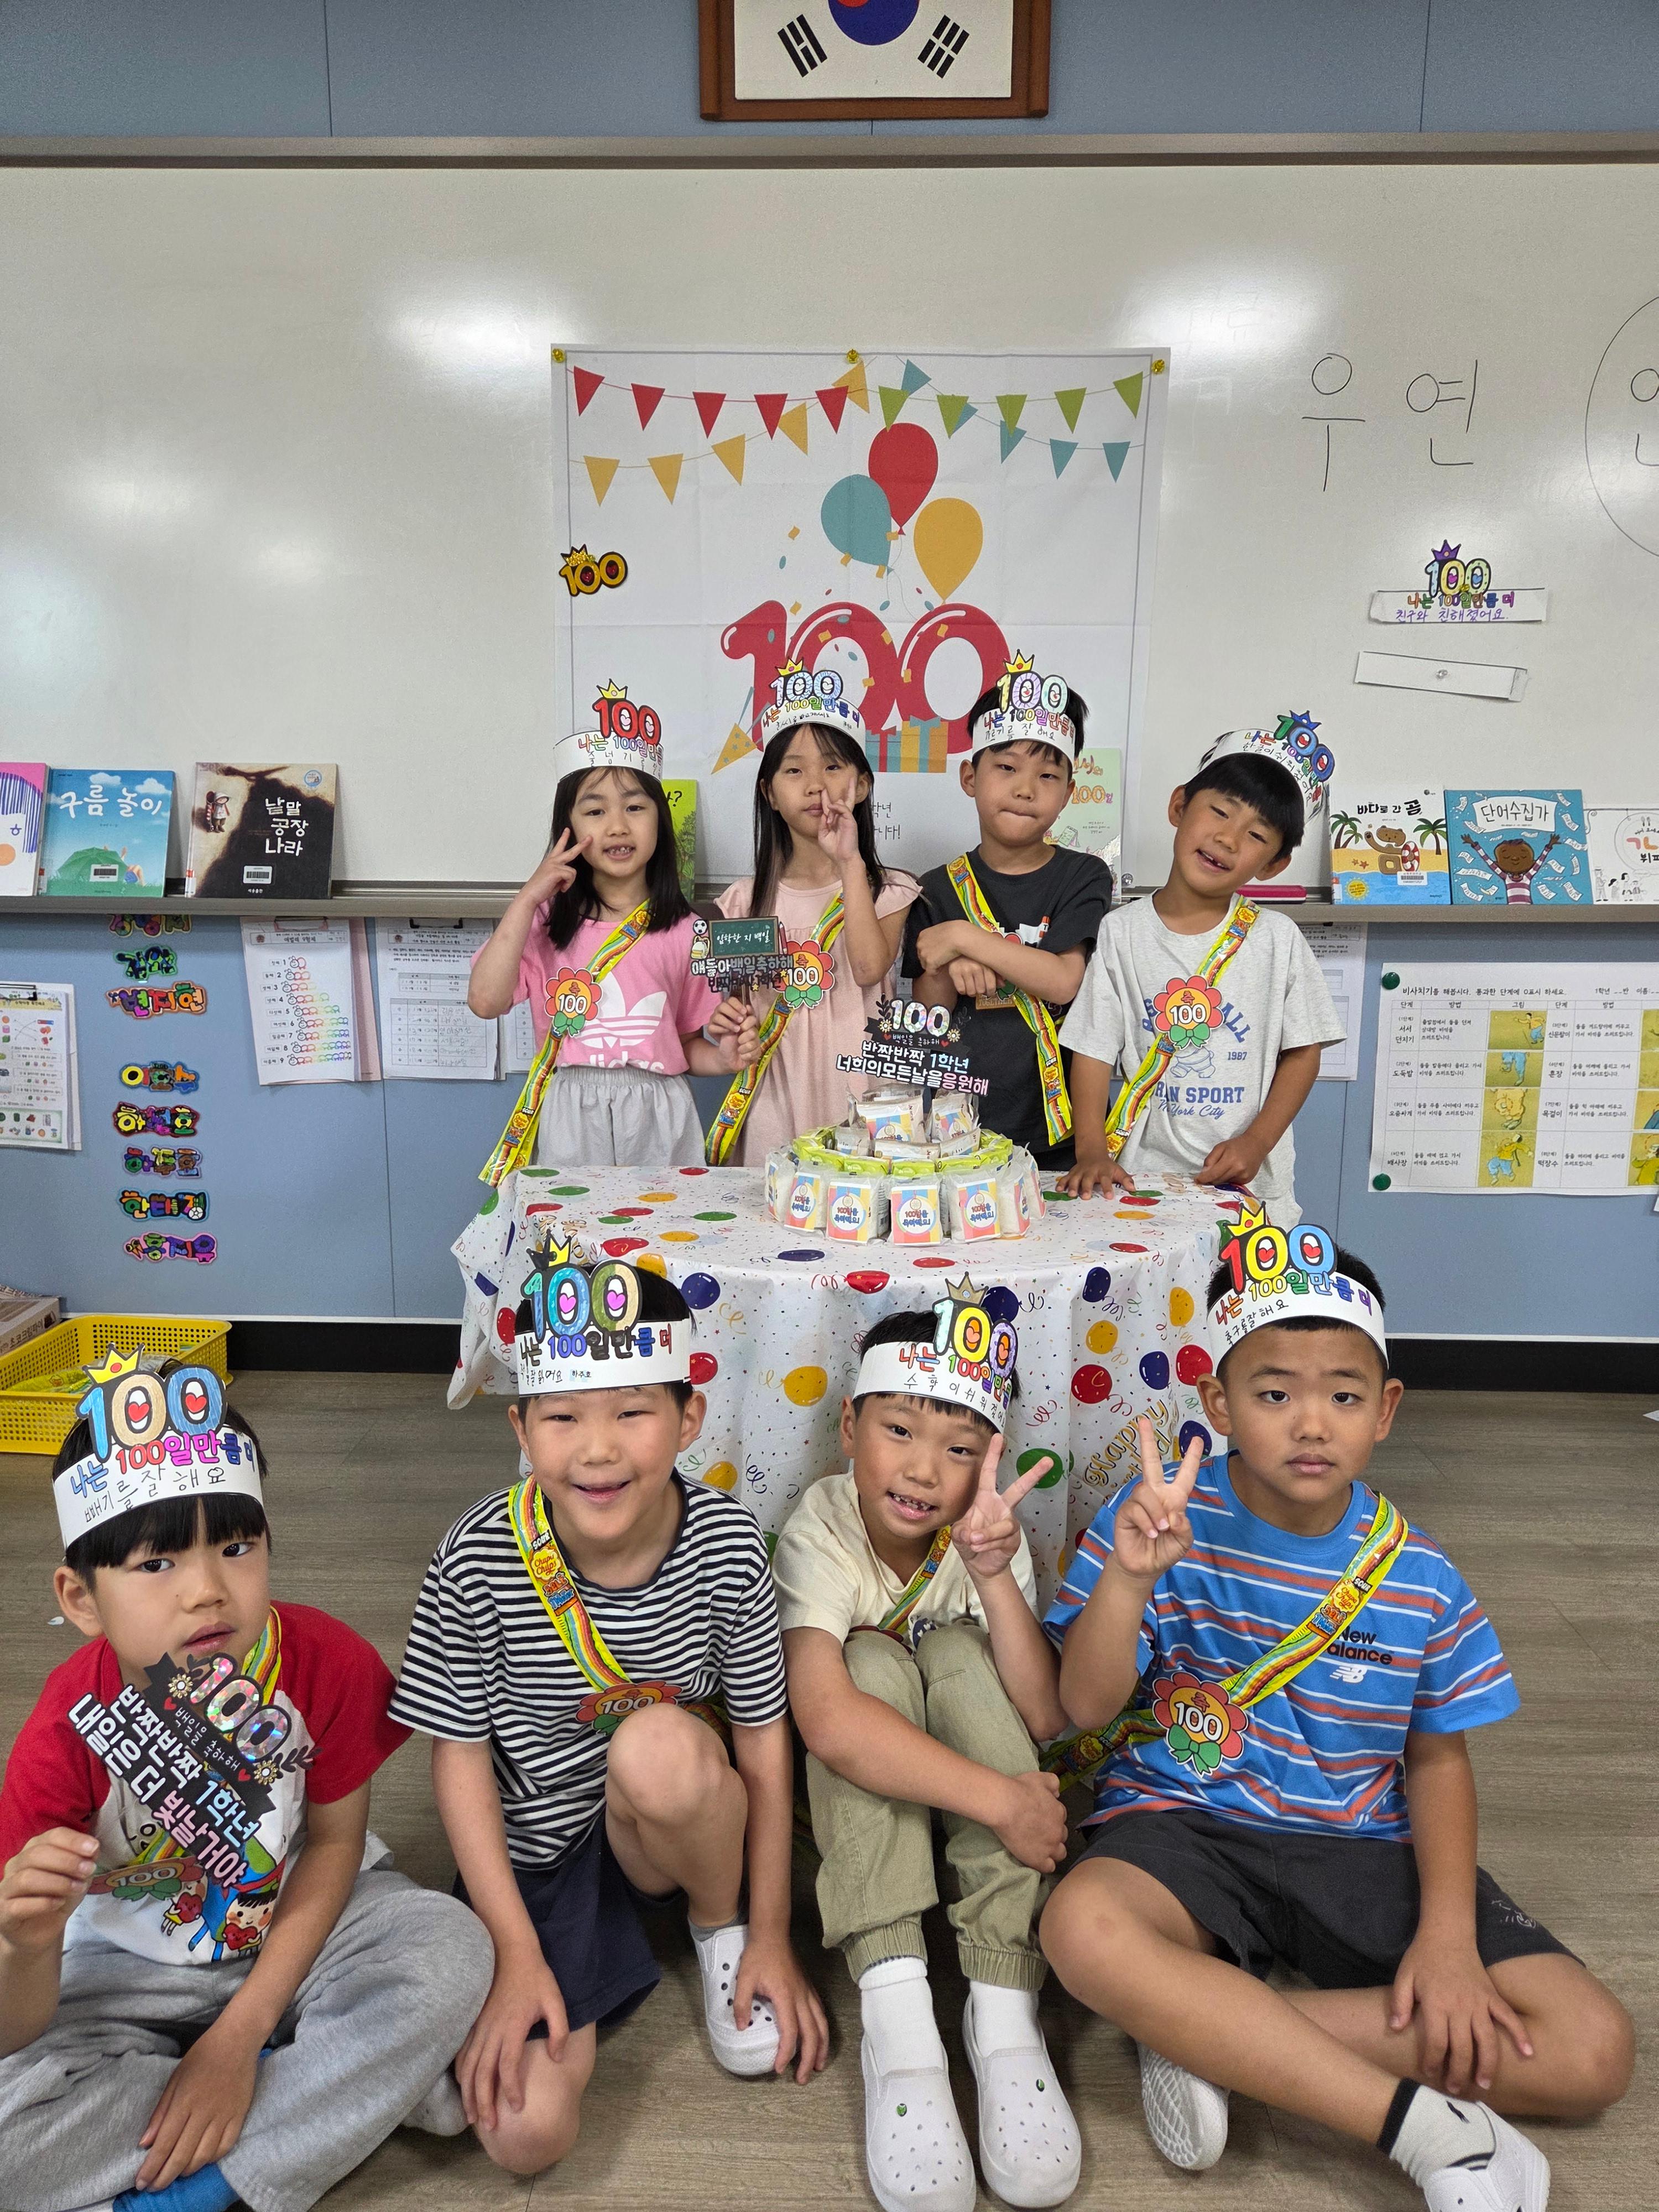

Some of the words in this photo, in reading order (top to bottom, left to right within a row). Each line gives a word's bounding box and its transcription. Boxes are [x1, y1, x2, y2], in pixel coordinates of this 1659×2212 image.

[559, 551, 628, 597] 100
[1425, 558, 1491, 597] 100
[1408, 592, 1433, 609] 나는
[1439, 592, 1499, 609] 100일만큼
[1503, 591, 1515, 608] 더
[1396, 609, 1428, 622] 친구와
[721, 600, 1011, 755] 100
[769, 670, 843, 708] 100
[996, 671, 1069, 714] 100
[592, 697, 661, 745] 100
[763, 708, 781, 728] 나는
[984, 711, 1005, 730] 나는
[578, 734, 608, 752] 나는
[1244, 730, 1276, 746] 나는
[1274, 714, 1335, 782] 100
[59, 784, 109, 818] 구름
[117, 786, 162, 817] 놀이
[265, 797, 302, 816] 낱말
[1357, 804, 1388, 815] 바다로
[1392, 805, 1402, 813] 간
[1404, 799, 1421, 816] 곰
[1481, 801, 1549, 822] 단어수집가
[270, 817, 309, 837] 공장
[265, 837, 303, 857] 나라
[717, 933, 742, 945] 입학한
[754, 930, 771, 943] 백일
[787, 966, 820, 986] 100
[1402, 986, 1438, 996] 비사치기를
[1443, 988, 1471, 996] 해봅시다.
[557, 994, 587, 1015] 100
[1170, 1003, 1207, 1025] 100
[890, 999, 951, 1037] 100
[893, 1034, 913, 1045] 백일을
[918, 1037, 940, 1047] 축하해
[1396, 1035, 1415, 1044] 던지기
[862, 1041, 925, 1067] 반짝반짝
[930, 1053, 969, 1074] 1학년
[1227, 1051, 1248, 1061] 1987
[1186, 1087, 1245, 1103] SPORT
[1199, 1104, 1225, 1119] City
[1218, 1223, 1337, 1295] 100
[520, 1260, 643, 1344] 100
[1215, 1295, 1244, 1326] 나는
[1249, 1270, 1354, 1302] 100일만큼
[1358, 1288, 1373, 1316] 더
[1225, 1318, 1249, 1345] 축구를
[1259, 1300, 1289, 1317] 해요
[520, 1335, 542, 1367] 나는
[548, 1326, 656, 1361] 100일만큼
[660, 1322, 672, 1354] 더
[932, 1297, 1018, 1380] 100
[899, 1344, 940, 1372] 나는
[571, 1370, 592, 1379] 하주호
[75, 1364, 226, 1463] 100
[70, 1460, 109, 1498] 나는
[116, 1428, 242, 1475] 100일만큼
[85, 1479, 138, 1524] 빼기를
[141, 1465, 166, 1498] 잘
[173, 1466, 226, 1492] 해요
[533, 1532, 551, 1550] SOUR
[536, 1559, 557, 1575] Chups
[1354, 1577, 1372, 1592] SOUR
[1336, 1592, 1354, 1609] Chups
[1341, 1587, 1357, 1604] Chupa
[1337, 1625, 1377, 1645] New
[1327, 1642, 1393, 1665] alance
[189, 1656, 293, 1765] 100
[601, 1695, 655, 1715] 100
[1174, 1700, 1223, 1741] 100
[68, 1692, 142, 1777] 내일은
[131, 1767, 167, 1805] 더
[175, 1707, 208, 1746] 백일을
[203, 1740, 241, 1772] 축하해
[110, 1684, 203, 1791] 반짝반짝
[195, 1779, 263, 1850] 1학년
[114, 1867, 177, 1887] 100
